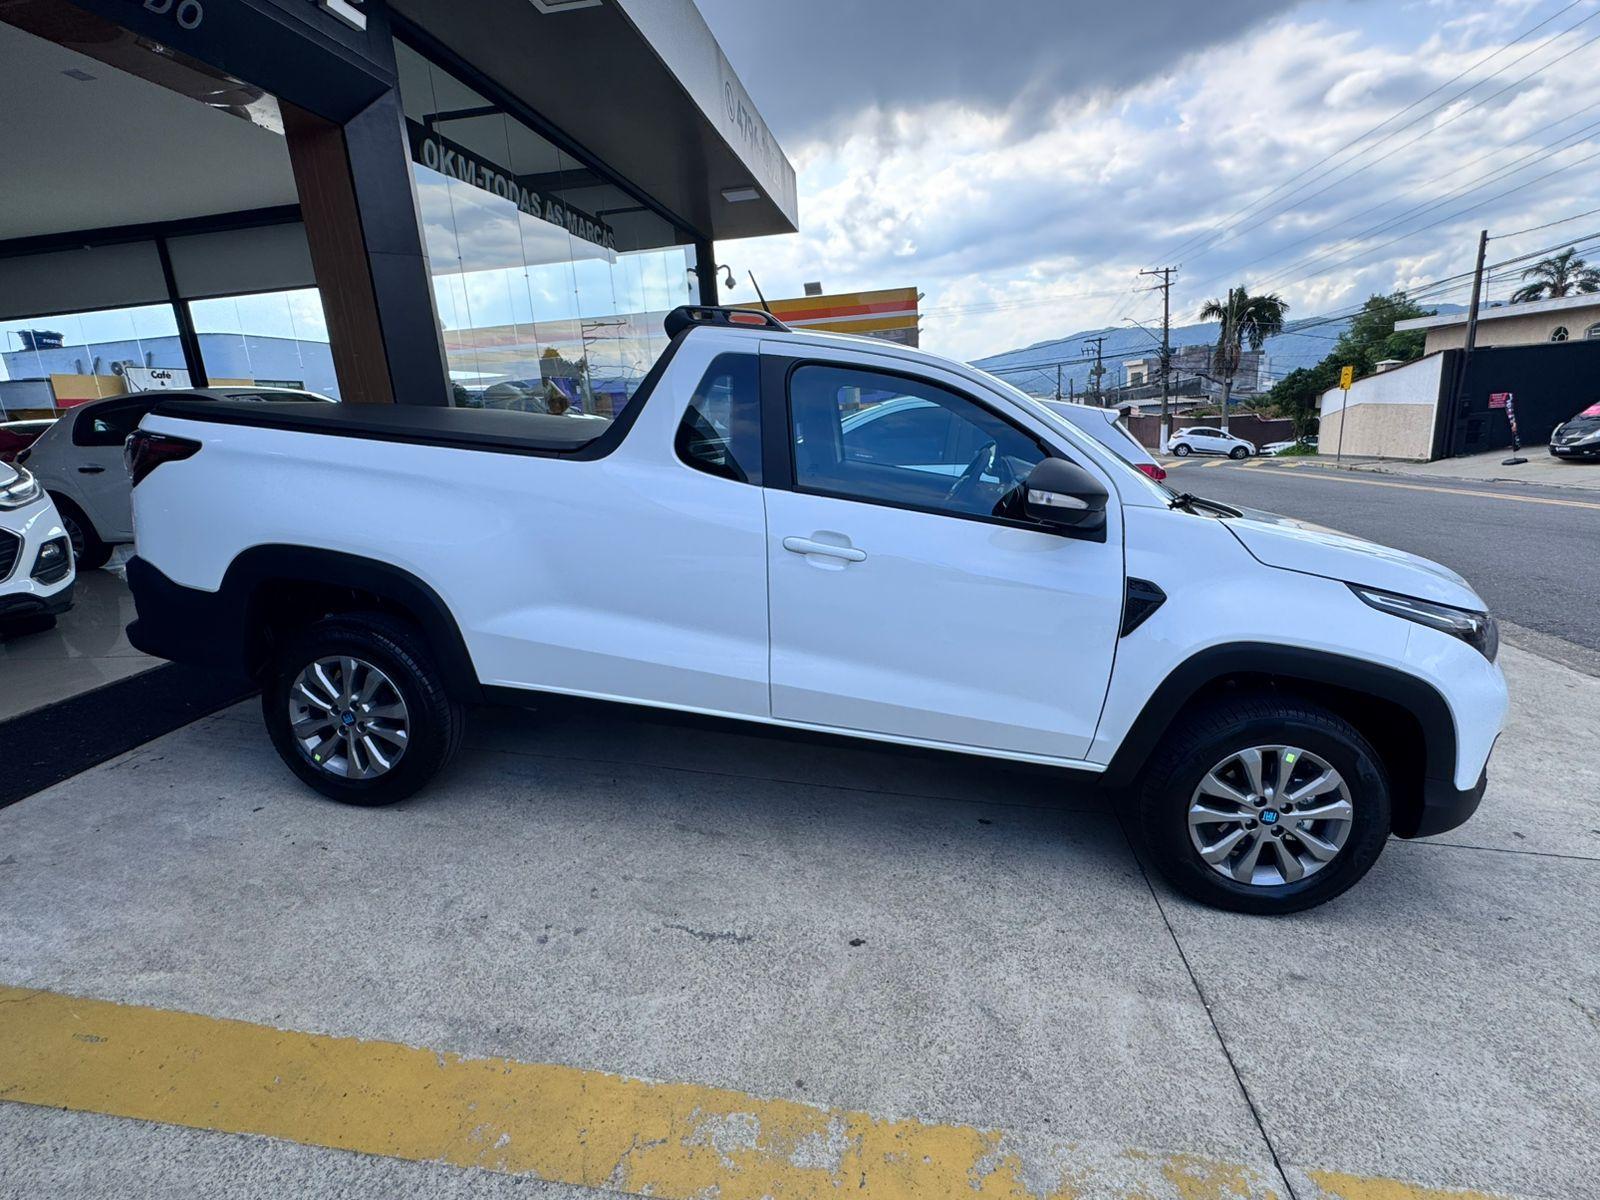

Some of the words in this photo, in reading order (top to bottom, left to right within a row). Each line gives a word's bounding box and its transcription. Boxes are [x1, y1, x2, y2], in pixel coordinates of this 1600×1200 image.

[545, 200, 564, 227] AS
[565, 209, 616, 249] MARCAS
[150, 370, 172, 379] Café
